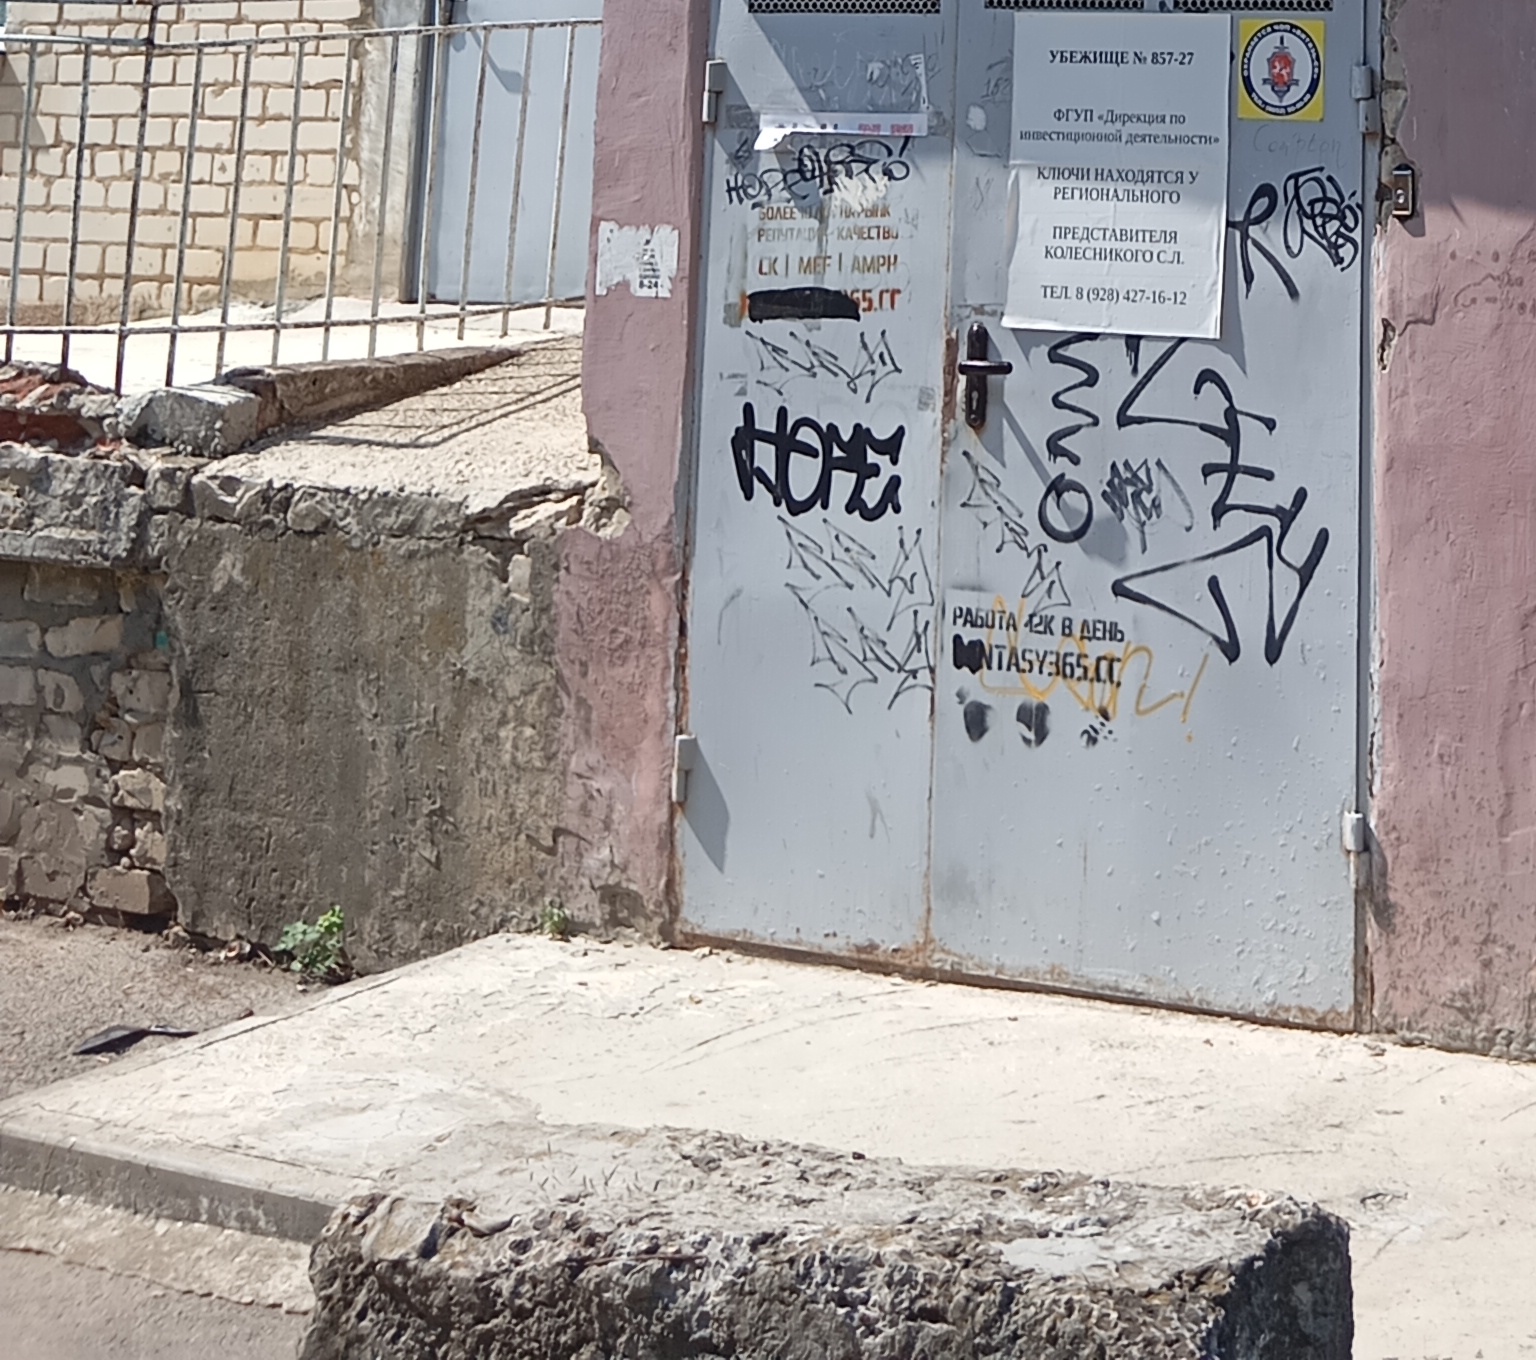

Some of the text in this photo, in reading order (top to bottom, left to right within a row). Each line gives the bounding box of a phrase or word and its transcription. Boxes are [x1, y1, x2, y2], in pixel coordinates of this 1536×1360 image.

[1049, 50, 1195, 67] УБЕЖИЩЕ № 857-27
[1053, 108, 1186, 127] ФГУП «Дирекция по
[1019, 129, 1220, 146] инвестиционной деятельности»
[1037, 166, 1199, 185] КЛЮЧИ НАХОДЯТСЯ У
[1053, 186, 1181, 204] РЕГИОНАЛЬНОГО
[1052, 225, 1178, 245] ПРЕДСТАВИТЕЛЯ
[1044, 245, 1185, 265] КОЛЕСНИКОГО С.Л.
[1075, 286, 1084, 300] 8
[1086, 286, 1120, 304] (928)
[1122, 289, 1188, 306] 427-16-12
[952, 605, 1017, 632] РАБОТА
[1061, 617, 1074, 637] В
[1080, 619, 1126, 643] ДЕНЬ
